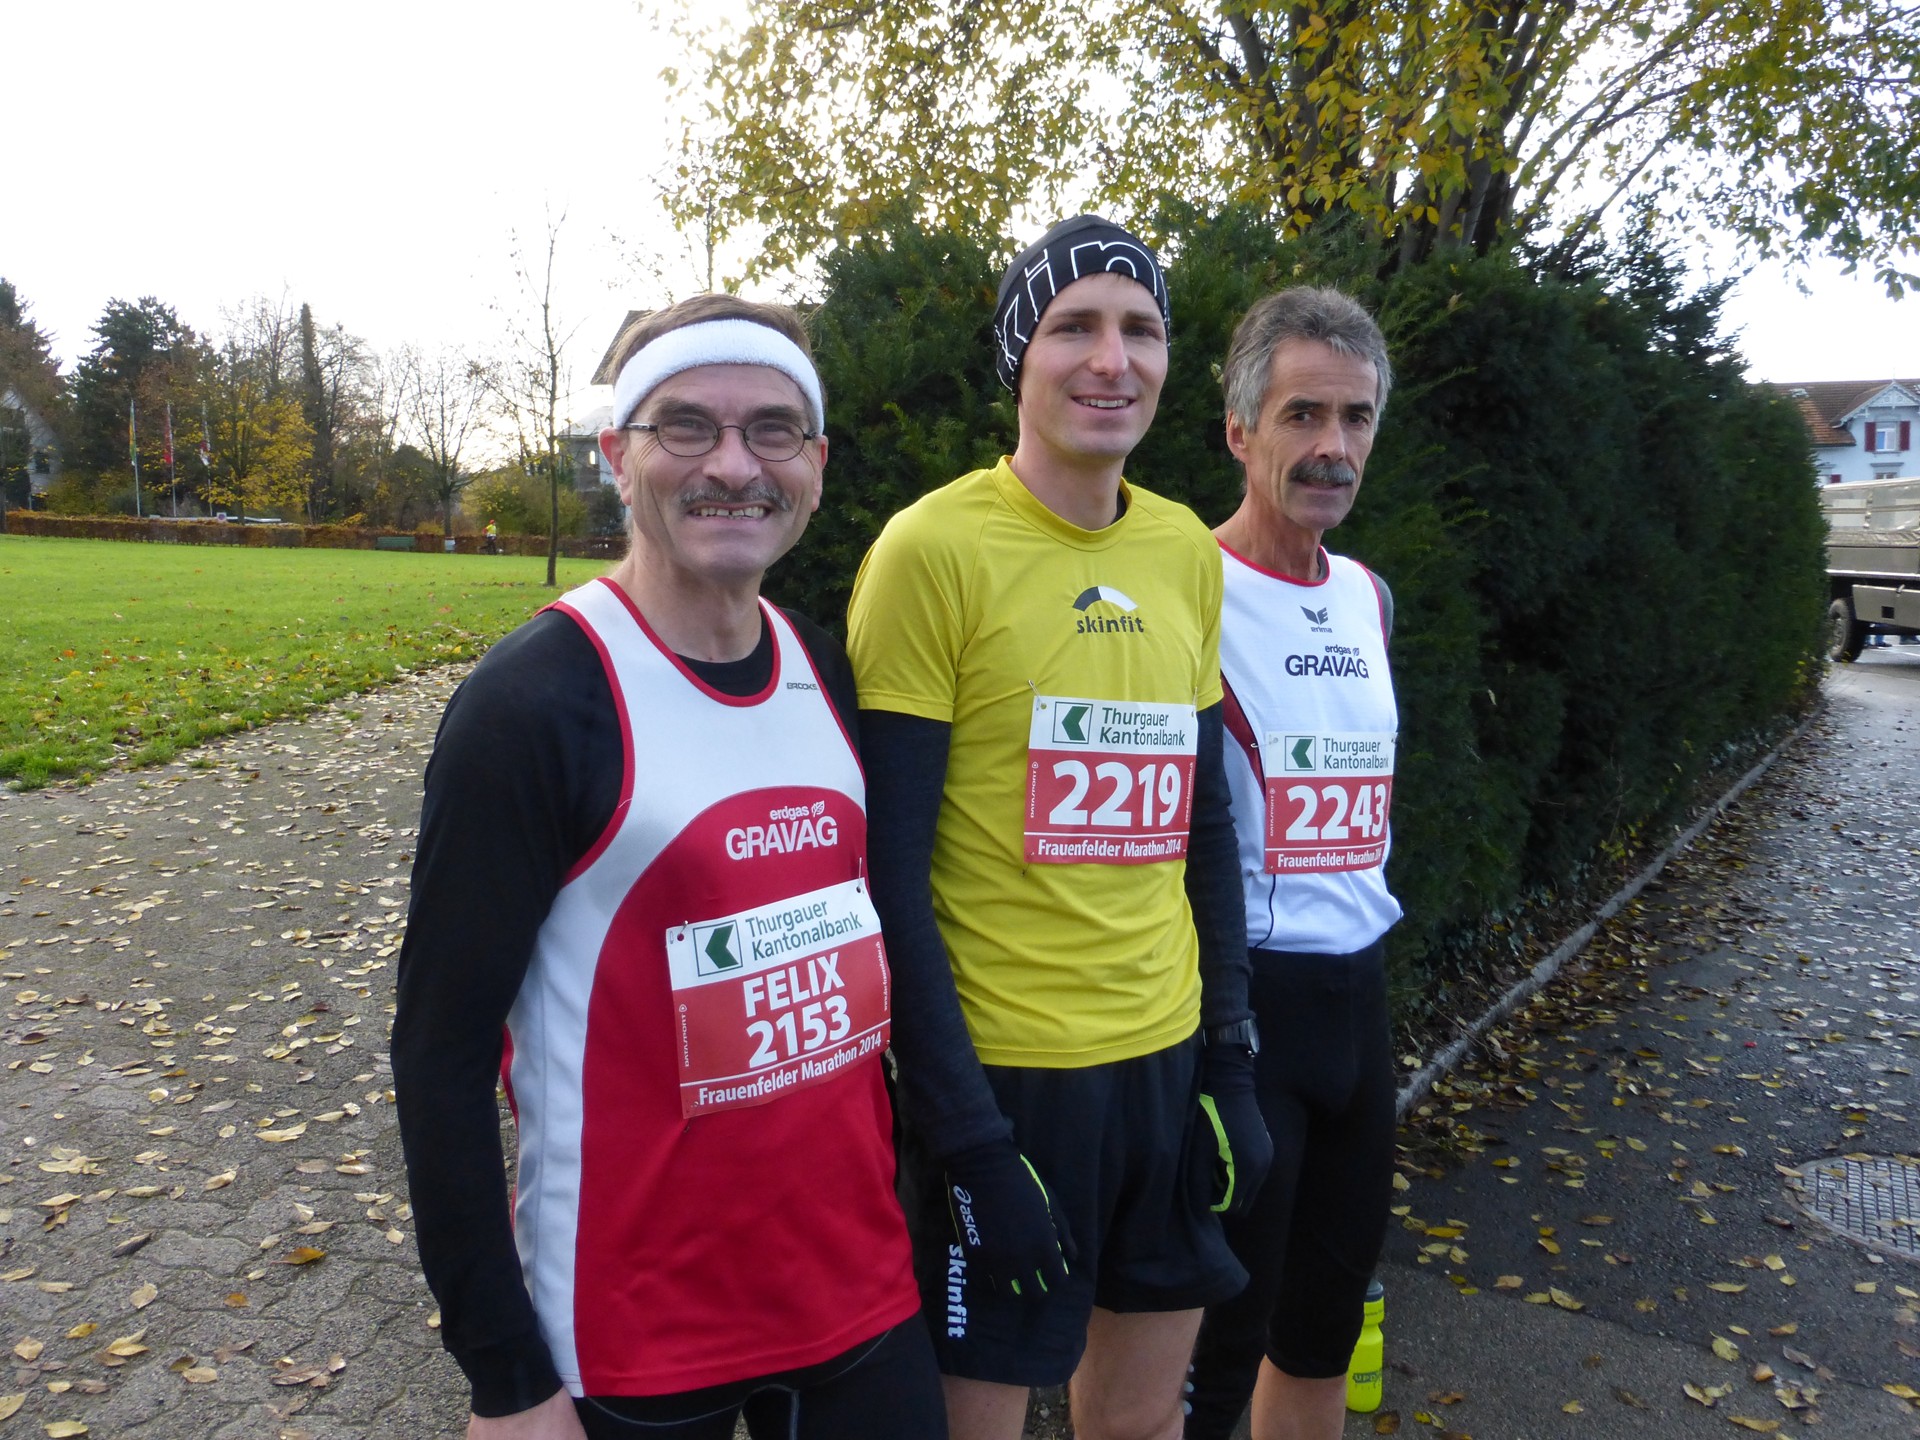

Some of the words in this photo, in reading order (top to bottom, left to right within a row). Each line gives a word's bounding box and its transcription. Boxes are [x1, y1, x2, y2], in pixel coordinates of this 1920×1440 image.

[1077, 615, 1145, 634] skinfit
[1324, 644, 1351, 655] erdgas
[1285, 654, 1369, 679] GRAVAG
[786, 682, 818, 690] BROOKS
[1102, 707, 1169, 727] Thurgauer
[1099, 727, 1185, 746] Kantonalbank
[1323, 738, 1381, 755] Thurgauer
[1323, 753, 1389, 770] Kantonalbank
[1049, 759, 1181, 827] 2219
[770, 805, 810, 822] erdgas
[1286, 783, 1387, 841] 2243
[725, 815, 838, 861] GRAVAG
[1037, 838, 1121, 857] Frauenfelder
[1123, 840, 1165, 858] Marathon
[1165, 838, 1181, 855] 2014
[1277, 850, 1345, 869] Frauenfelder
[1346, 849, 1375, 866] Marathon
[745, 899, 829, 938] Thurgauer
[751, 911, 863, 961] Kantonalbank
[742, 951, 845, 1018] FELIX
[746, 994, 851, 1069] 2153
[698, 1067, 799, 1106] Frauenfelder
[801, 1048, 857, 1081] Marathon
[859, 1031, 882, 1057] 2014
[959, 1204, 981, 1247] asics
[947, 1244, 968, 1338] skinfit
